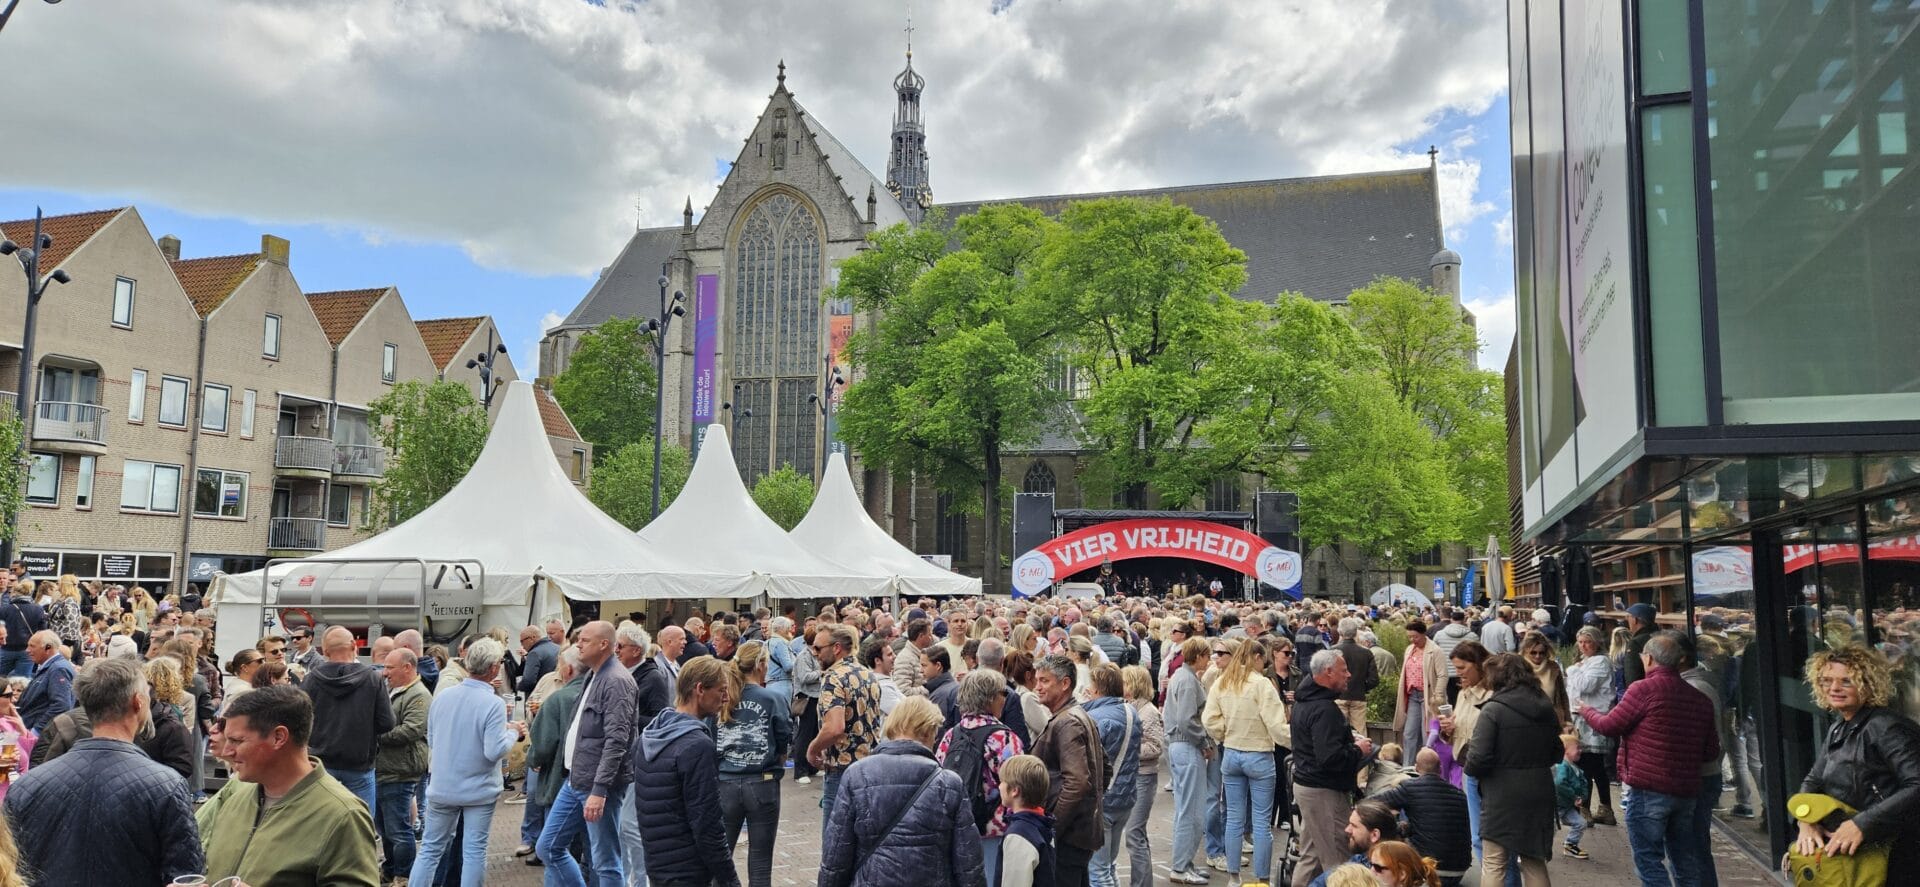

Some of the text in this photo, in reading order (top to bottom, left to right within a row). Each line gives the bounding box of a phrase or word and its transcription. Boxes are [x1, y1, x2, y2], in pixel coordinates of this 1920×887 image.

[1054, 527, 1250, 567] VIER VRIJHEID
[1267, 561, 1291, 572] 5 MEI
[1020, 567, 1043, 577] 5 MEI
[434, 606, 474, 616] HEINEKEN
